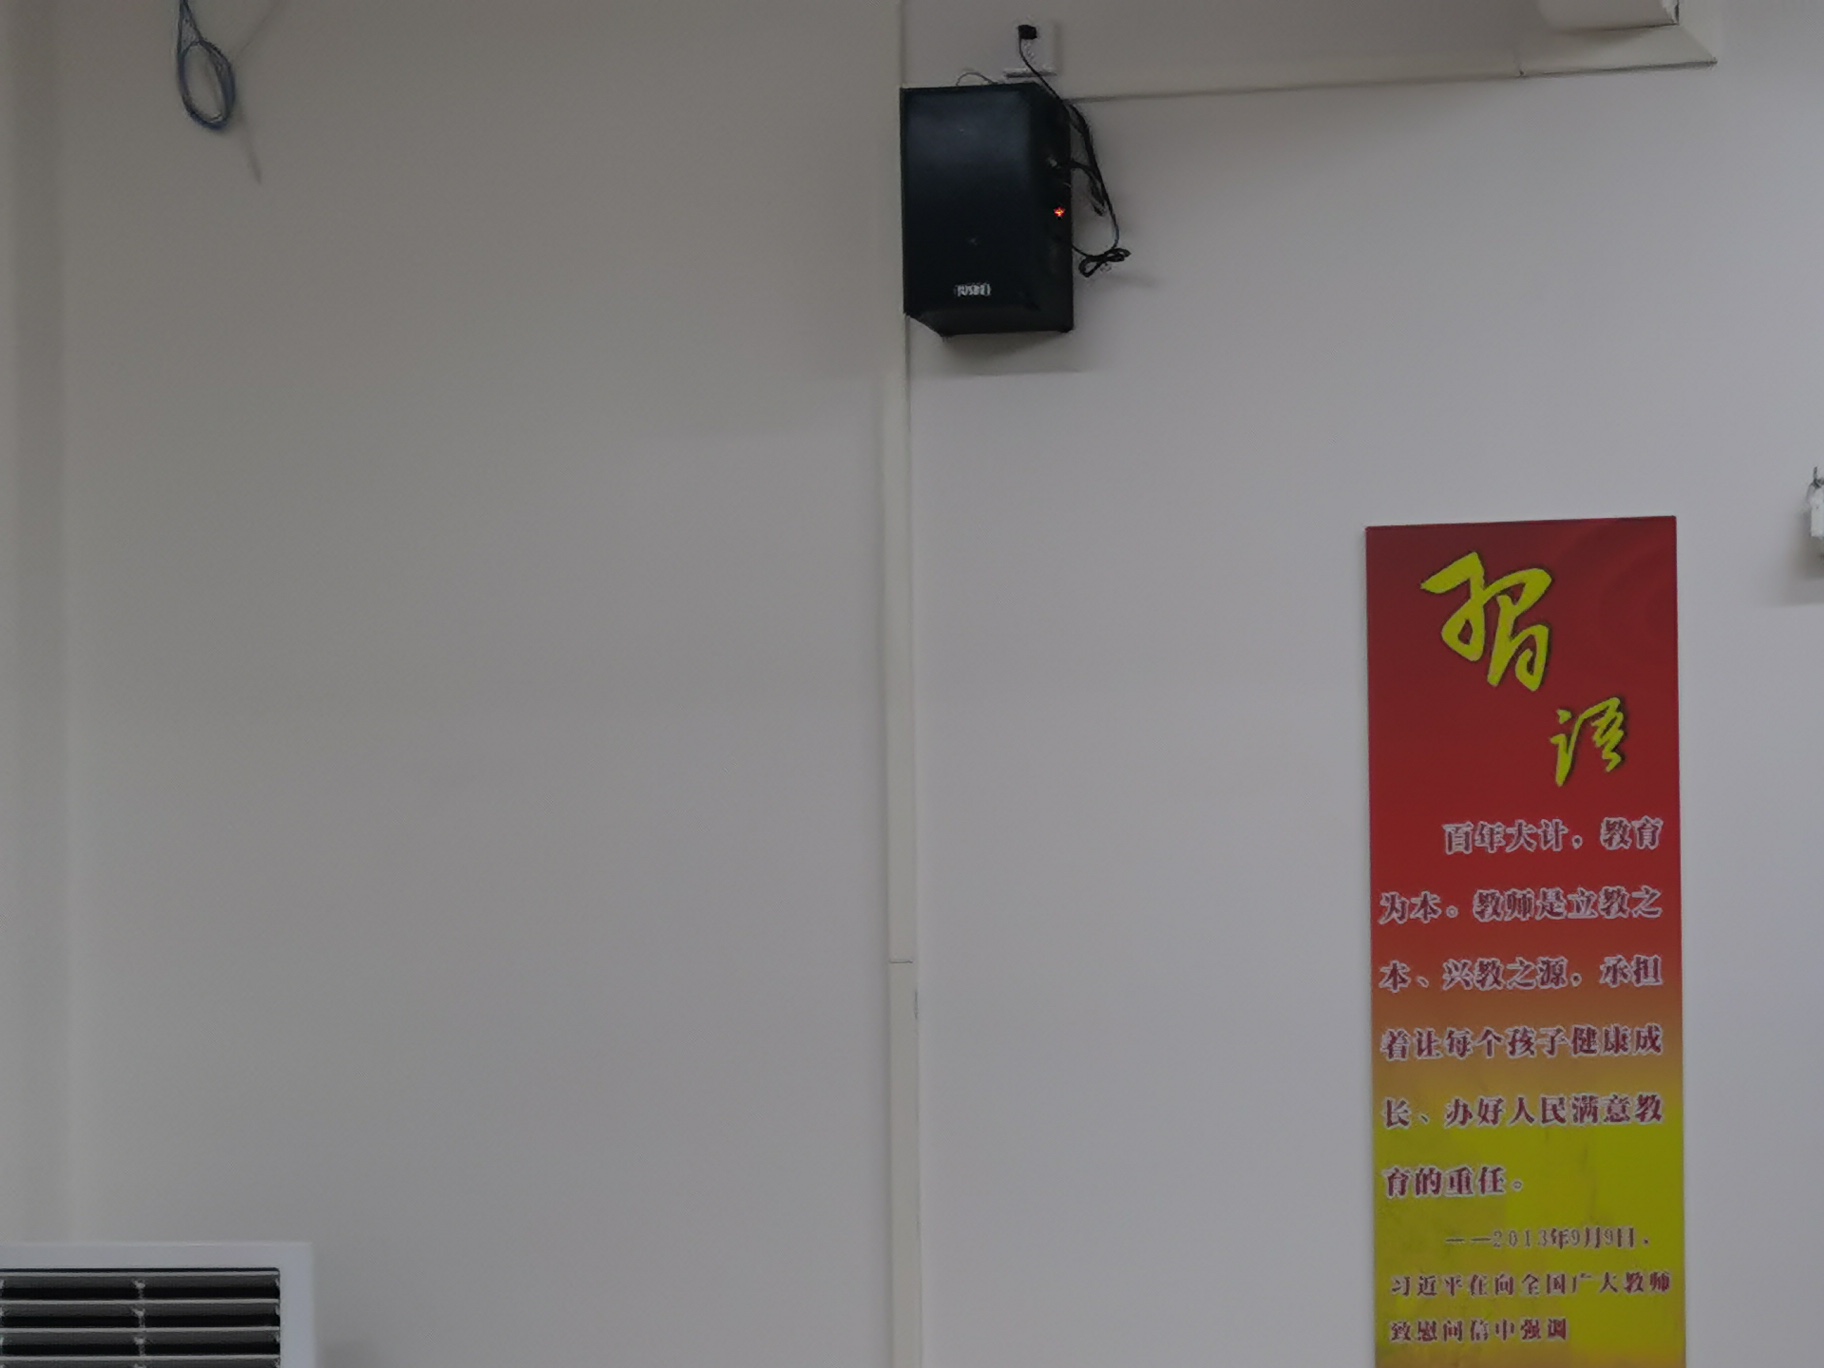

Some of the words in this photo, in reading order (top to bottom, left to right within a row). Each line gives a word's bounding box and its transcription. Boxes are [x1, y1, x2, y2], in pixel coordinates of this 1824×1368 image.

[1379, 885, 1662, 925] 为本。教师是立教之
[1381, 1024, 1663, 1060] 着让每个孩子健康成
[1381, 1093, 1664, 1130] 长、办好人民满意教
[1383, 1165, 1523, 1199] 育的重任。
[1391, 1271, 1671, 1298] 习近平在向全国广大教师
[1390, 1317, 1569, 1342] 致慰问信中强调
